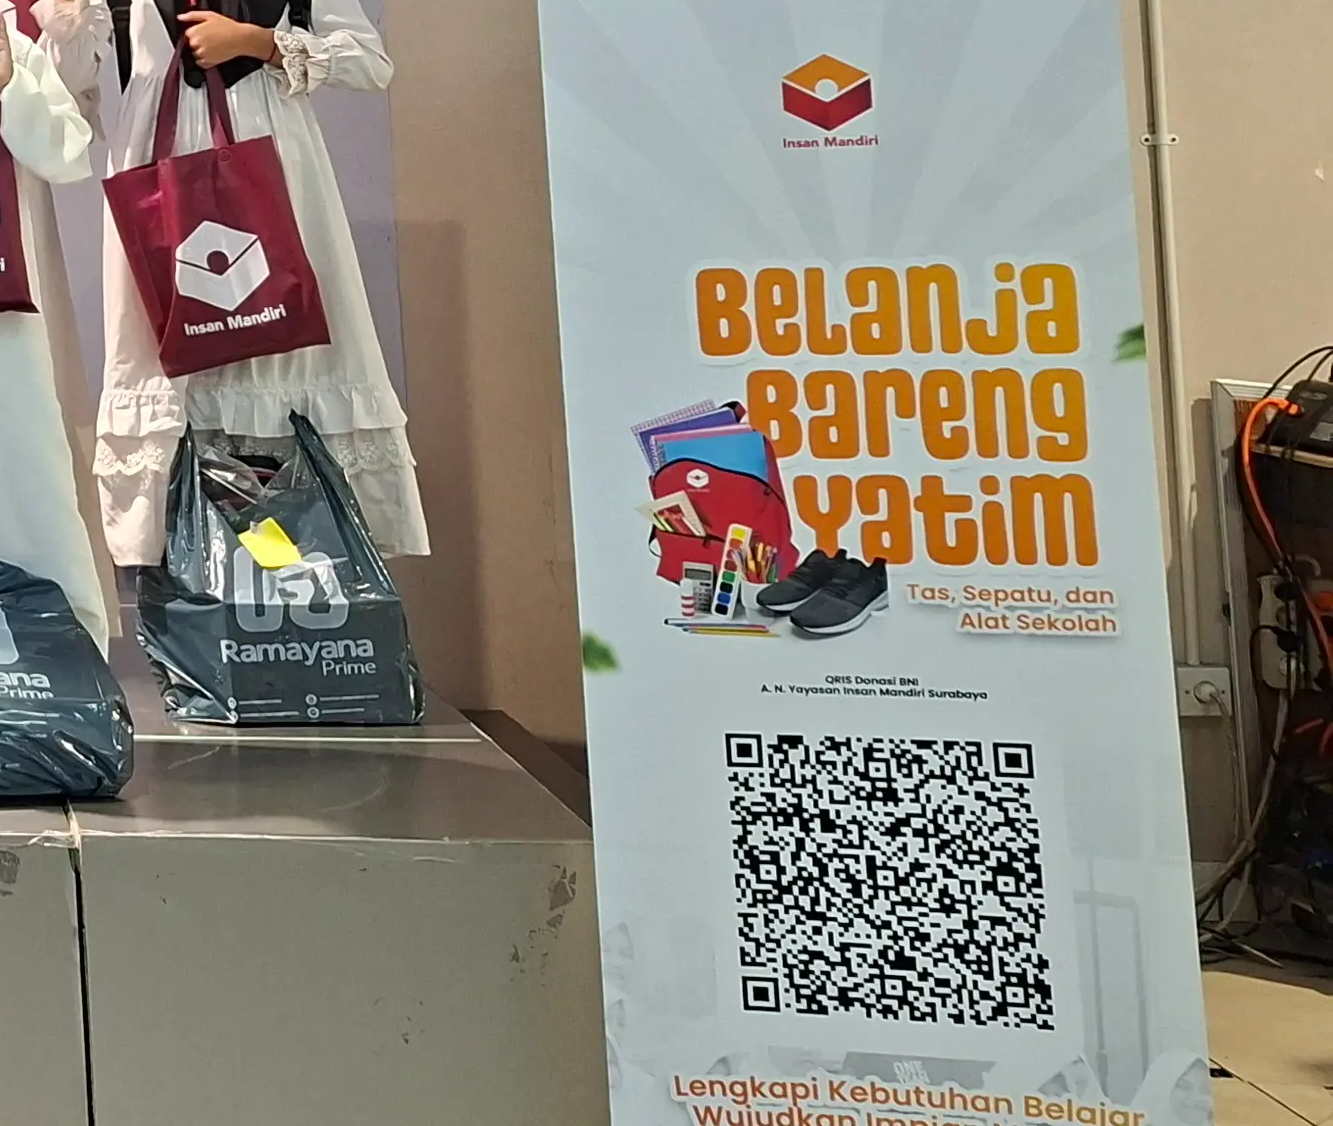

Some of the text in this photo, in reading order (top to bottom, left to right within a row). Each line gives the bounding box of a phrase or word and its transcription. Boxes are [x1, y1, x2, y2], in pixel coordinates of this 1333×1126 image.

[783, 134, 879, 149] Insan Mandiri
[184, 303, 288, 337] Insan Mandiri
[695, 262, 1080, 358] Belanja
[746, 367, 1089, 463] Bareng
[793, 473, 1099, 568] Yatim
[906, 583, 1115, 607] Tas, Sepatu, dan
[960, 612, 1117, 633] Alat Sekolah
[220, 637, 375, 666] Ramayana
[322, 659, 378, 676] Prime
[761, 684, 989, 702] A. N. Yayasan Insan Mandiri Surabaya
[825, 675, 920, 687] QRIS Donasi BNI
[674, 1075, 820, 1108] Lengkapi
[829, 1080, 1014, 1115] Kebutuhan
